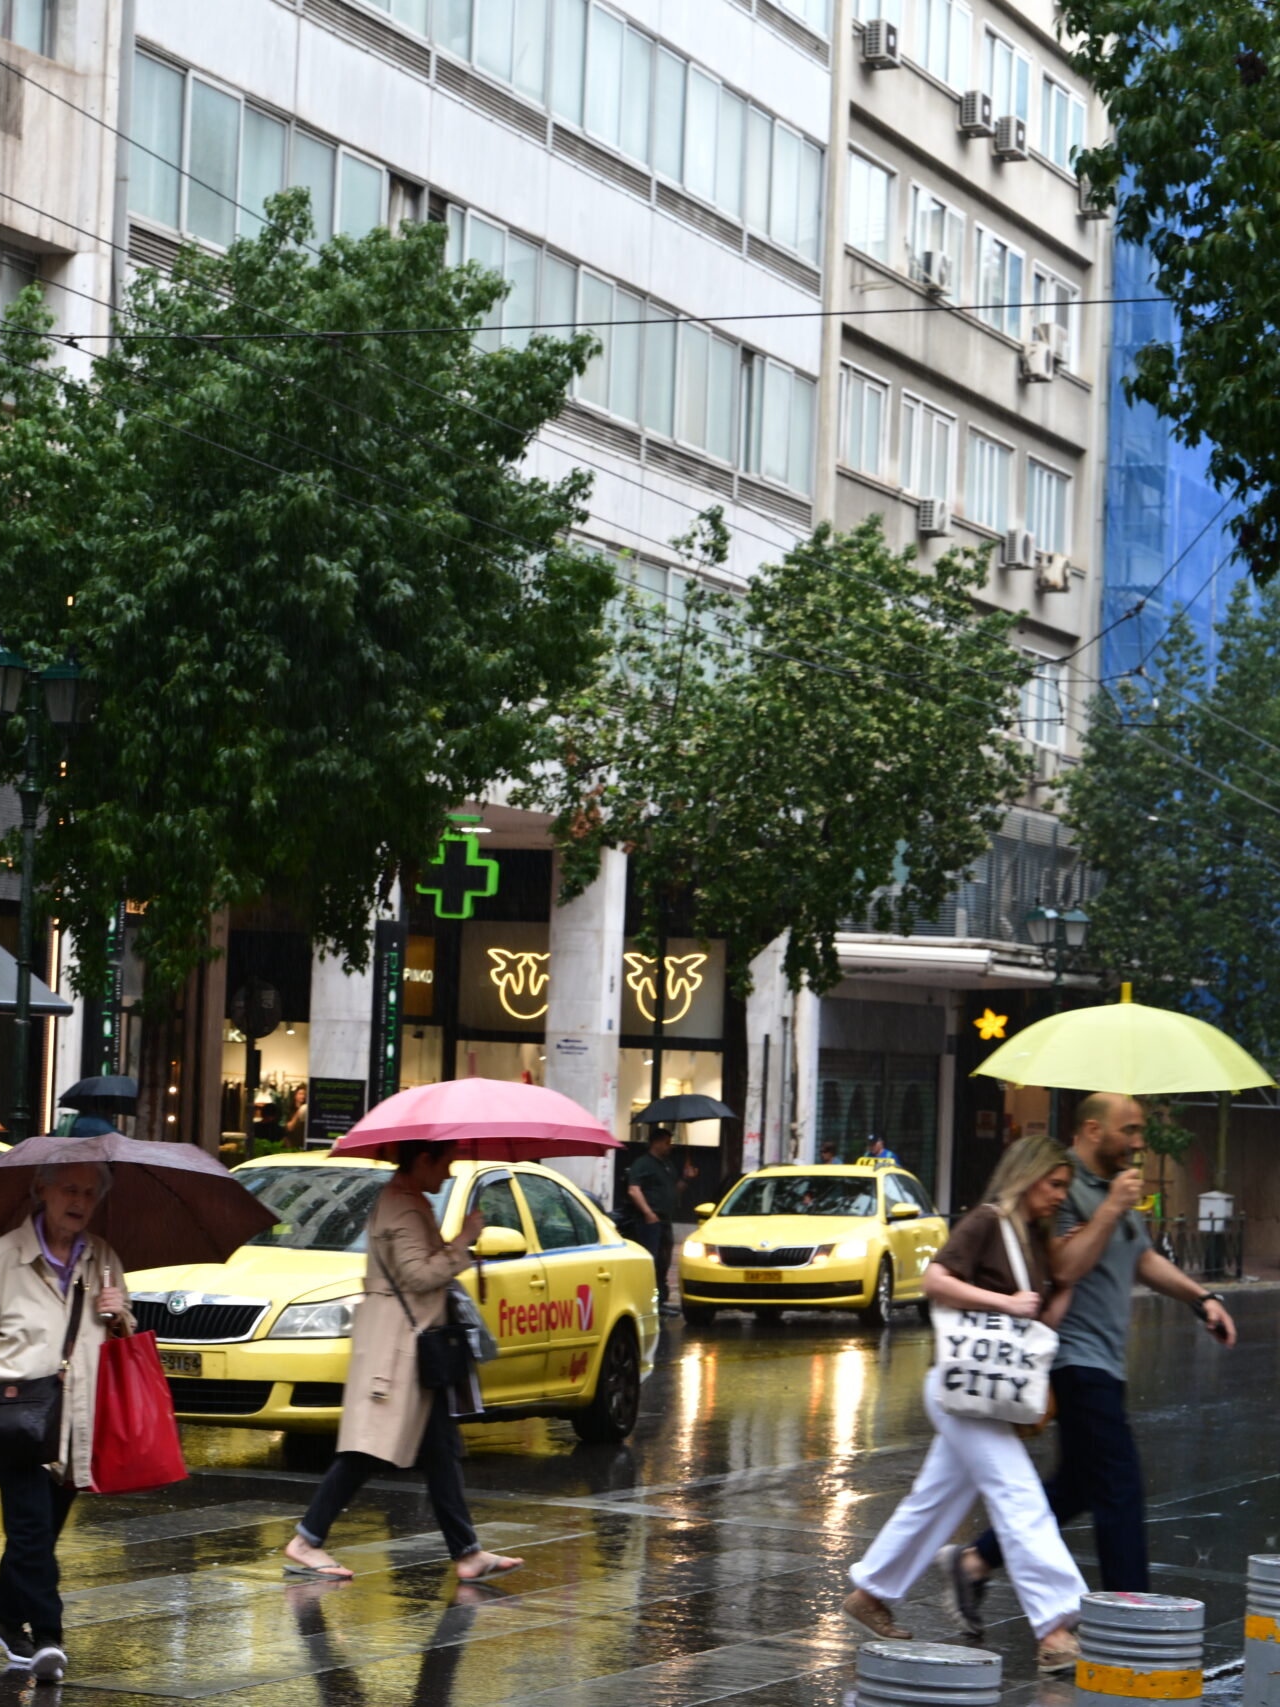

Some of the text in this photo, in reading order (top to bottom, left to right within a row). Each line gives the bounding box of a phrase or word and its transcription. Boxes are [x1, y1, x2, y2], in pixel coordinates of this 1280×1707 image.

[403, 967, 434, 984] PINKO
[958, 1311, 1032, 1337] NEW
[946, 1335, 1036, 1370] YORK
[944, 1366, 1030, 1403] CITY
